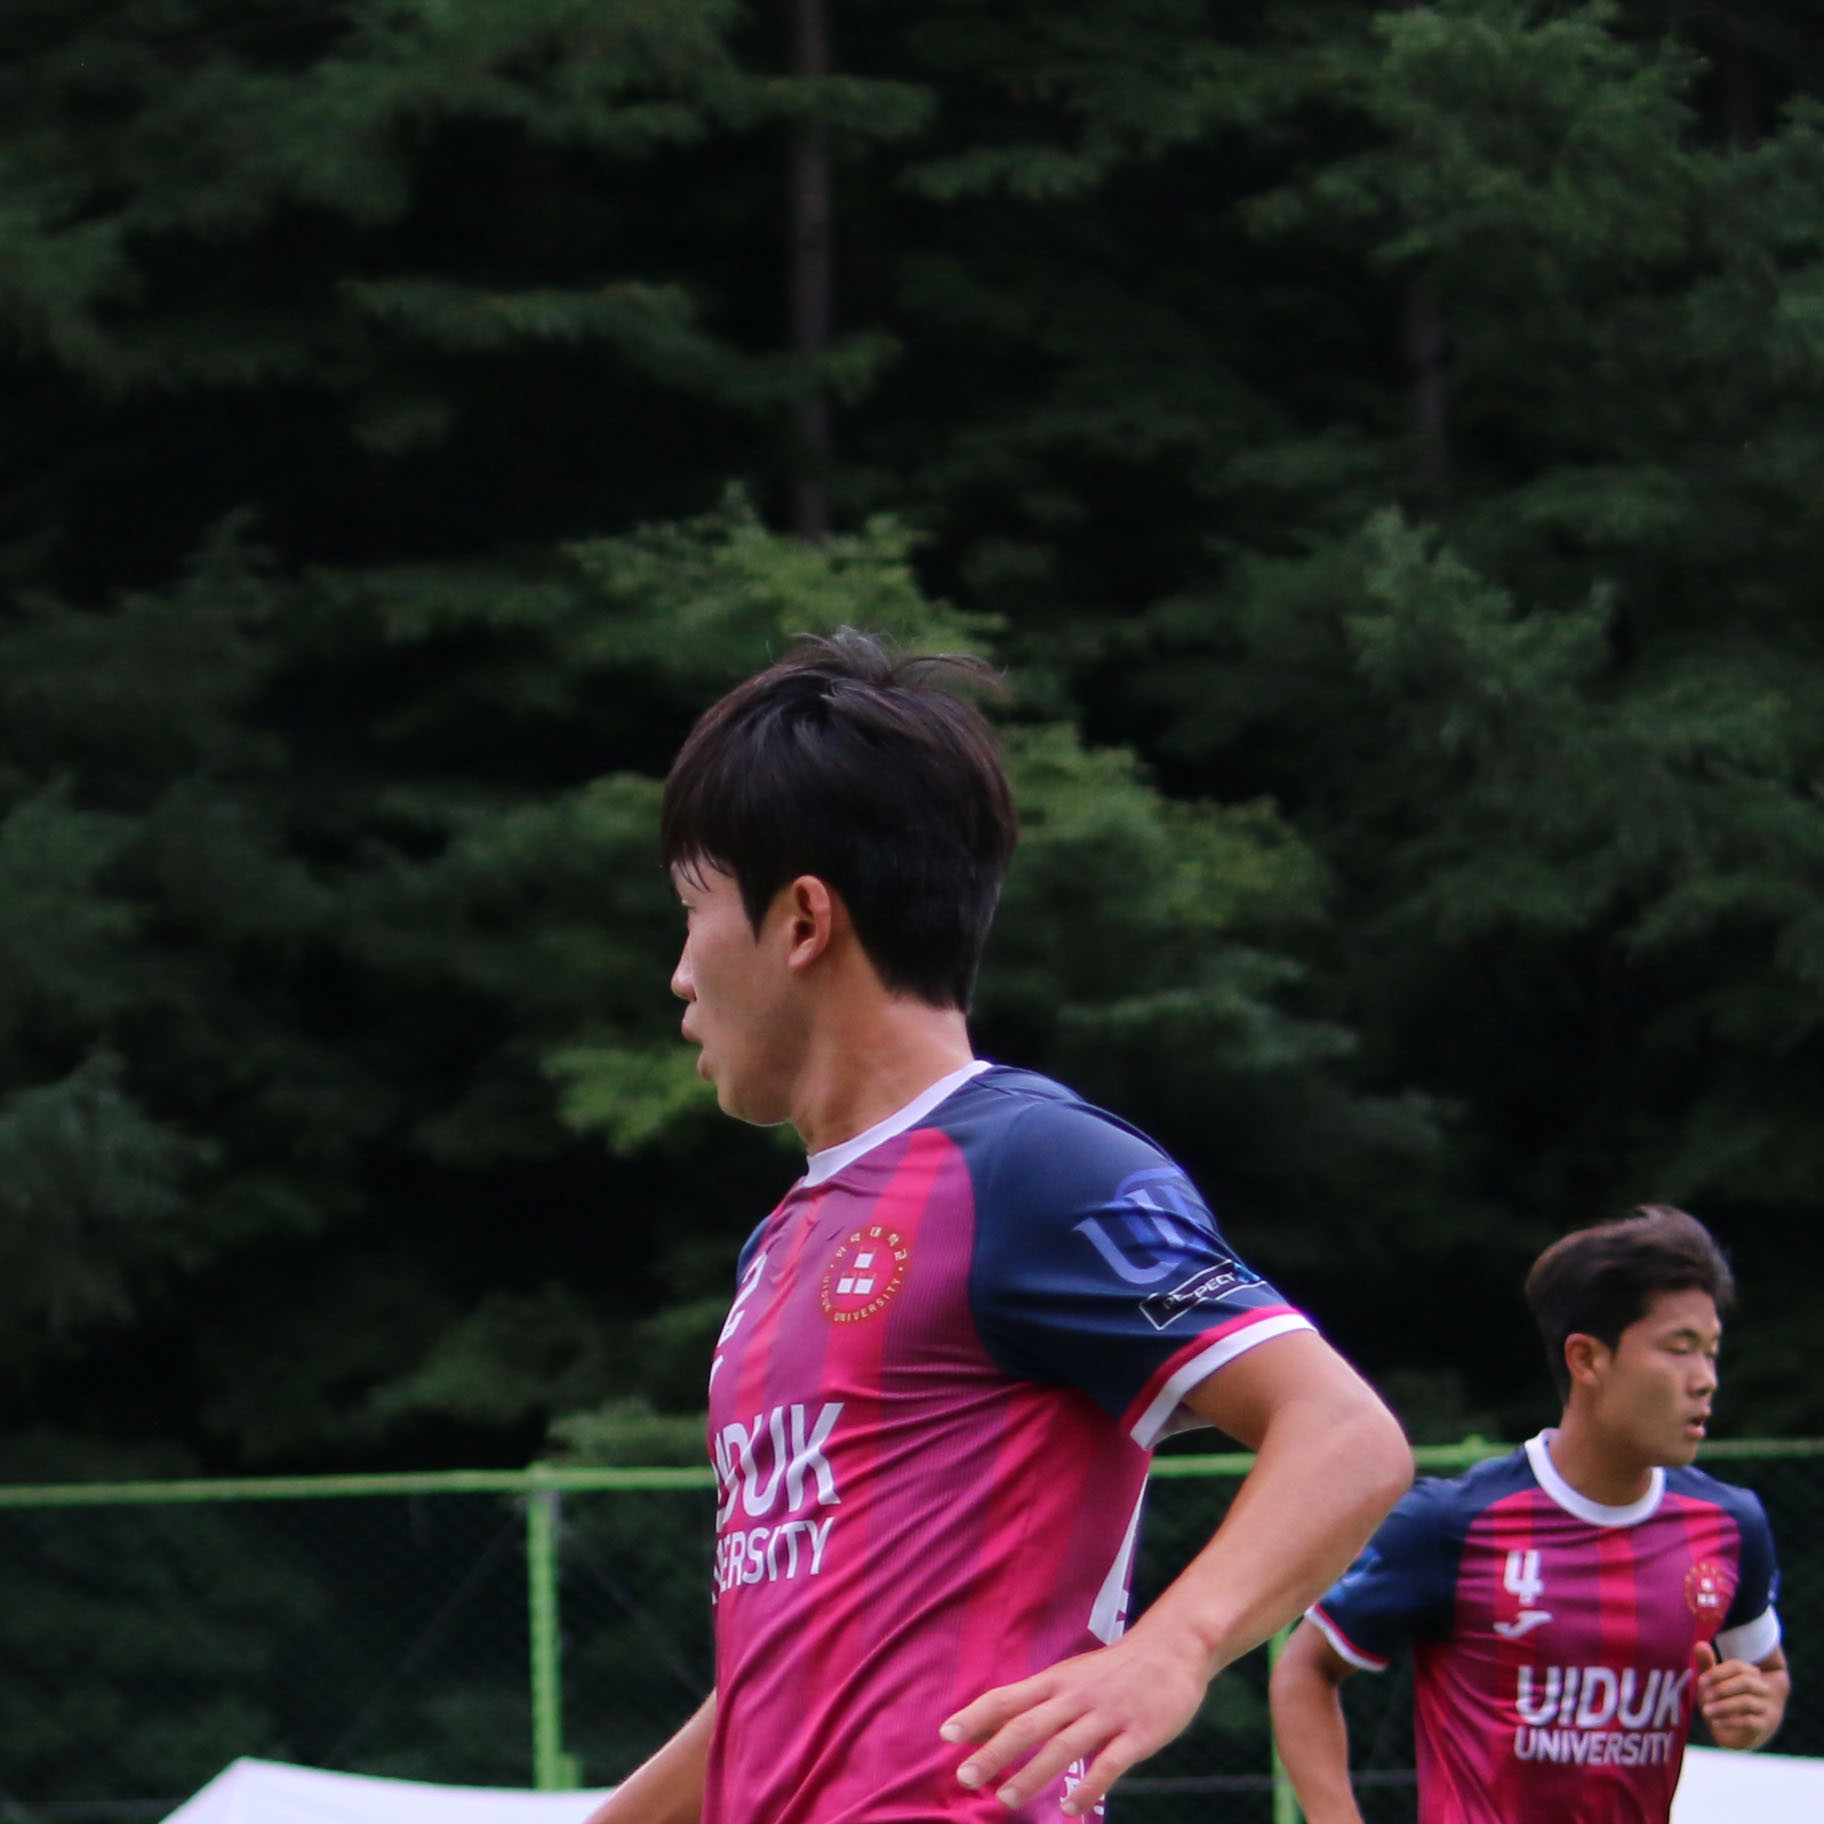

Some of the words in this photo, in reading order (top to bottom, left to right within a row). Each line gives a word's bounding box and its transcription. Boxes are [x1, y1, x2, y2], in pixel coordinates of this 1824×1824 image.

[1503, 1549, 1544, 1607] 4
[1515, 1664, 1695, 1729] UIDUK
[1513, 1726, 1673, 1766] UNIVERSITY
